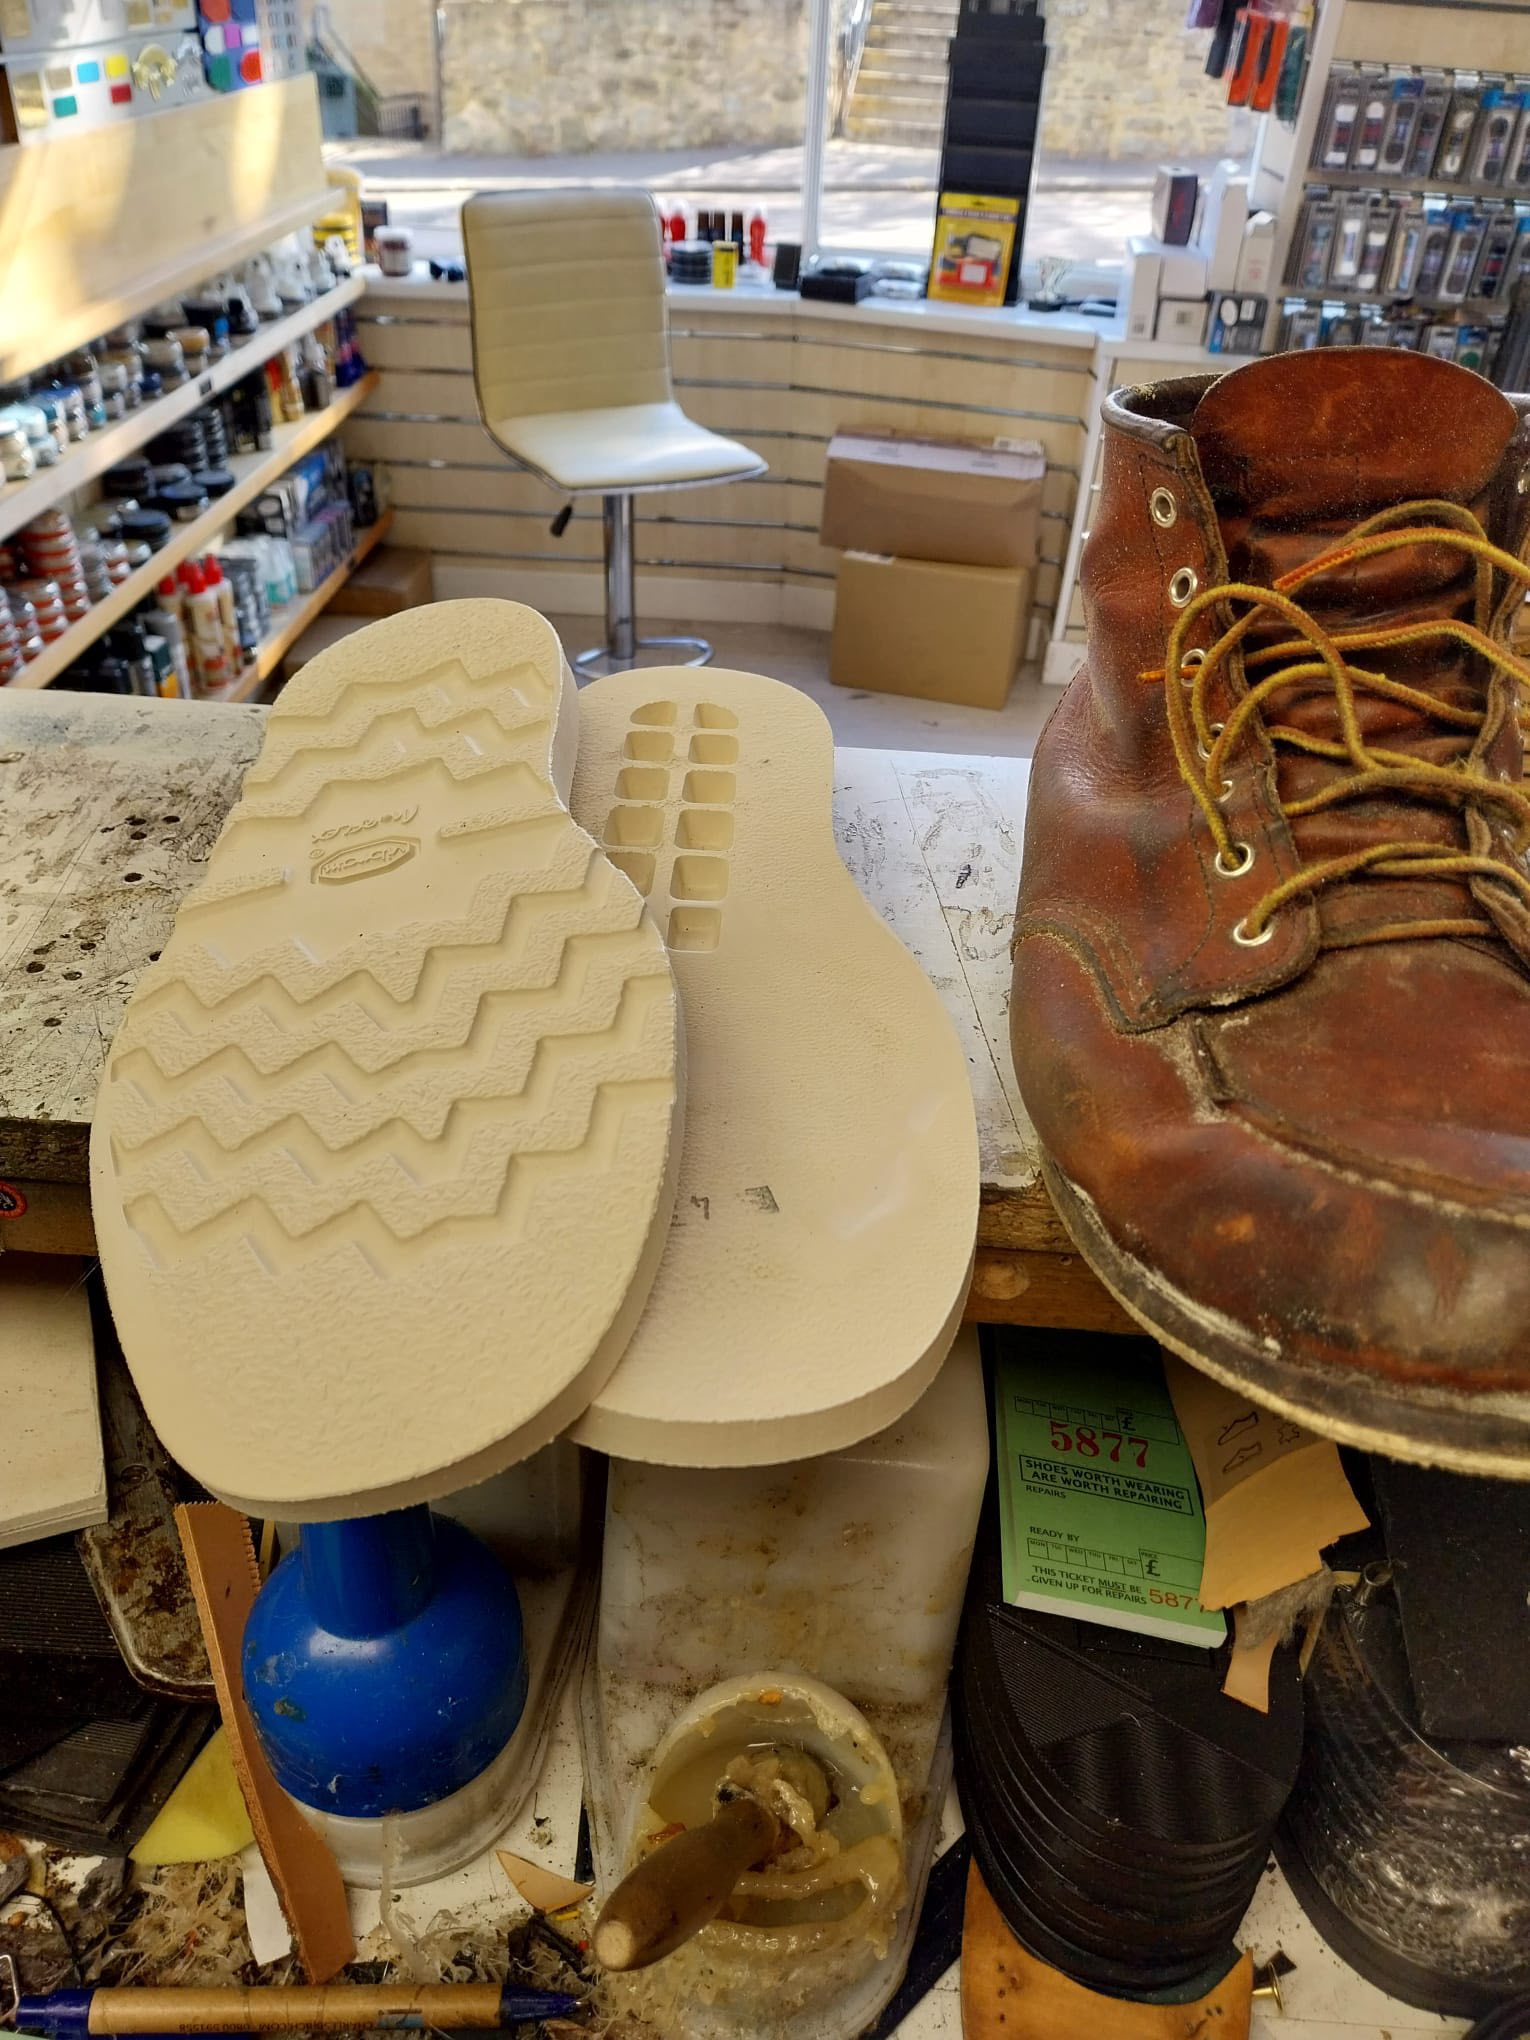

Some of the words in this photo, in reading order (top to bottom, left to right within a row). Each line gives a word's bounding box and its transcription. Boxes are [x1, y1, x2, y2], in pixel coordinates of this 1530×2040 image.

[1050, 1420, 1149, 1468] 5877
[1025, 1459, 1068, 1475] SHOES
[1072, 1468, 1120, 1487] WORTH
[1124, 1479, 1185, 1500] WEARING
[1025, 1484, 1067, 1499] REPAIRS
[1031, 1470, 1057, 1483] ARE
[1061, 1476, 1109, 1495] WORTH
[1114, 1487, 1182, 1510] REPAIRING
[1029, 1525, 1063, 1540] READY
[1066, 1531, 1080, 1543] BY
[1032, 1564, 1057, 1578] THIS
[1060, 1570, 1096, 1584] TICKET
[1098, 1578, 1127, 1591] MUST
[1129, 1584, 1142, 1594] BE
[1145, 1559, 1161, 1577] £
[1031, 1575, 1063, 1589] GIVEN
[1065, 1582, 1079, 1592] UP
[1081, 1584, 1102, 1597] FOR
[1105, 1590, 1148, 1605] REPAIRS
